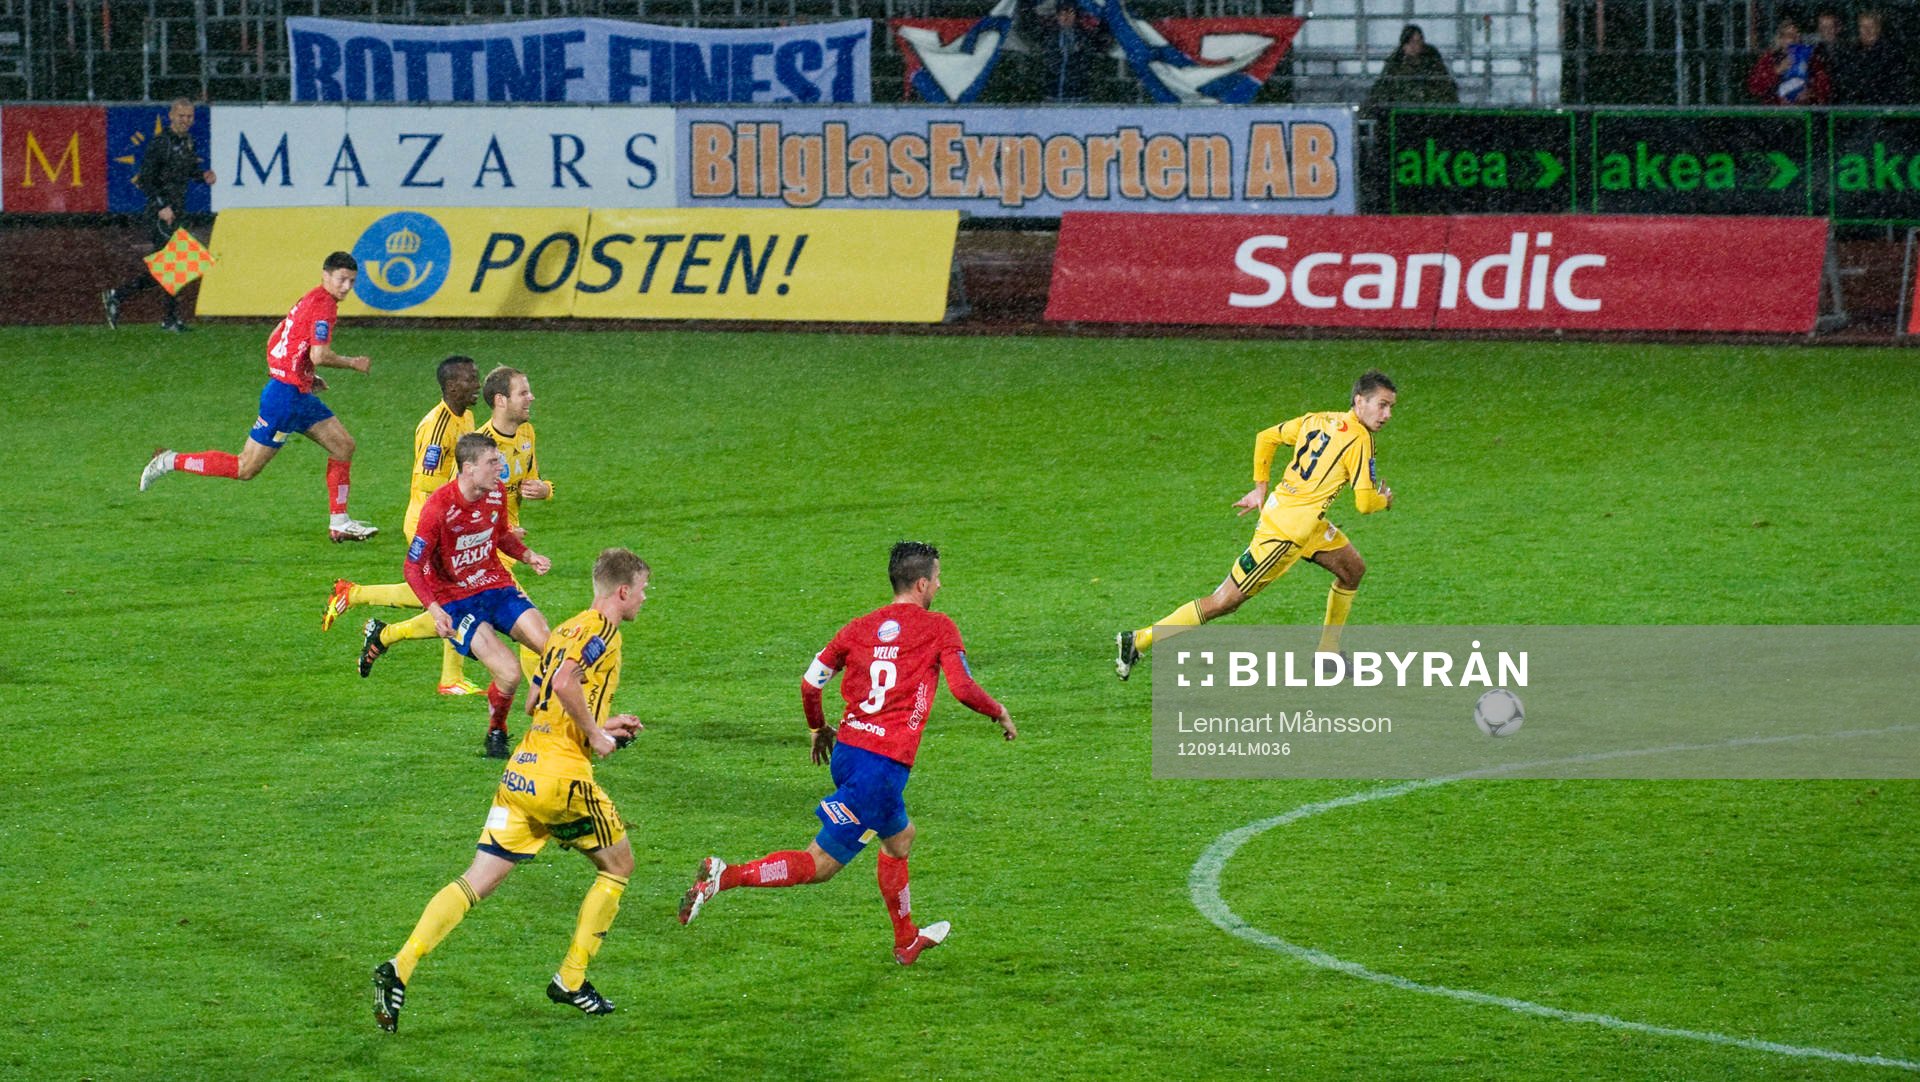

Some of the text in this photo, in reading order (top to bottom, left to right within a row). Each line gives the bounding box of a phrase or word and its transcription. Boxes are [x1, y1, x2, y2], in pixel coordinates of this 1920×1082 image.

[292, 29, 586, 102] ROTTNE
[608, 29, 867, 103] FINEST
[22, 130, 83, 187] M
[233, 132, 658, 190] MAZARS
[690, 120, 1338, 208] BilglasExperten AB
[1398, 138, 1508, 188] akea
[1601, 142, 1736, 190] akea
[470, 232, 809, 296] POSTEN!
[1228, 232, 1607, 313] Scandic
[1291, 429, 1331, 481] 13
[859, 660, 897, 714] 8
